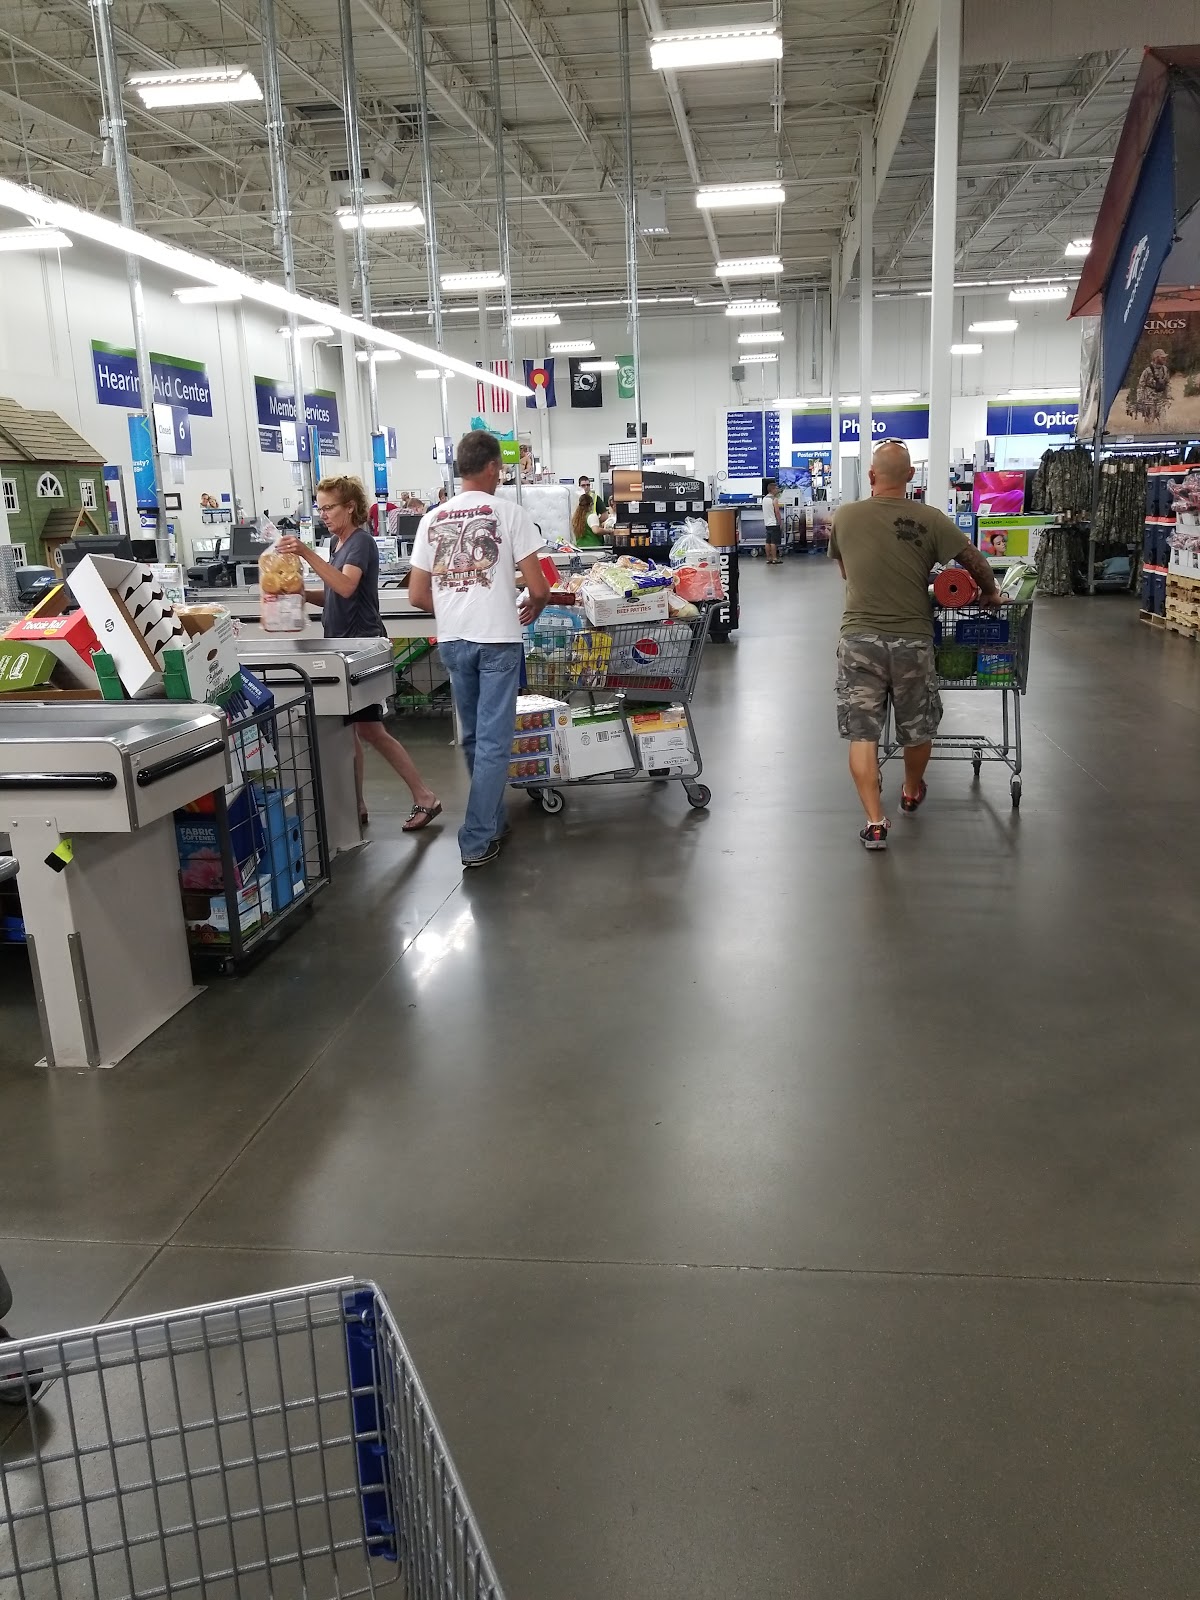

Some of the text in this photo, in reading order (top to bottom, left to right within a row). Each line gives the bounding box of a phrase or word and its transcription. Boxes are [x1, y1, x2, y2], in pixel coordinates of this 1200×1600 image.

[98, 363, 209, 403] Hearin Aid Center
[269, 396, 330, 422] Membe ervices
[842, 419, 887, 434] Phto
[1033, 411, 1080, 428] Optica
[159, 424, 172, 435] Closed
[179, 421, 186, 440] 6
[300, 436, 306, 452] 5
[390, 438, 395, 449] 4
[447, 445, 452, 456] 3
[675, 486, 685, 494] 10
[720, 555, 730, 623] DURACLL
[22, 619, 68, 630] Tootsie Roll
[180, 828, 215, 836] FABRIC
